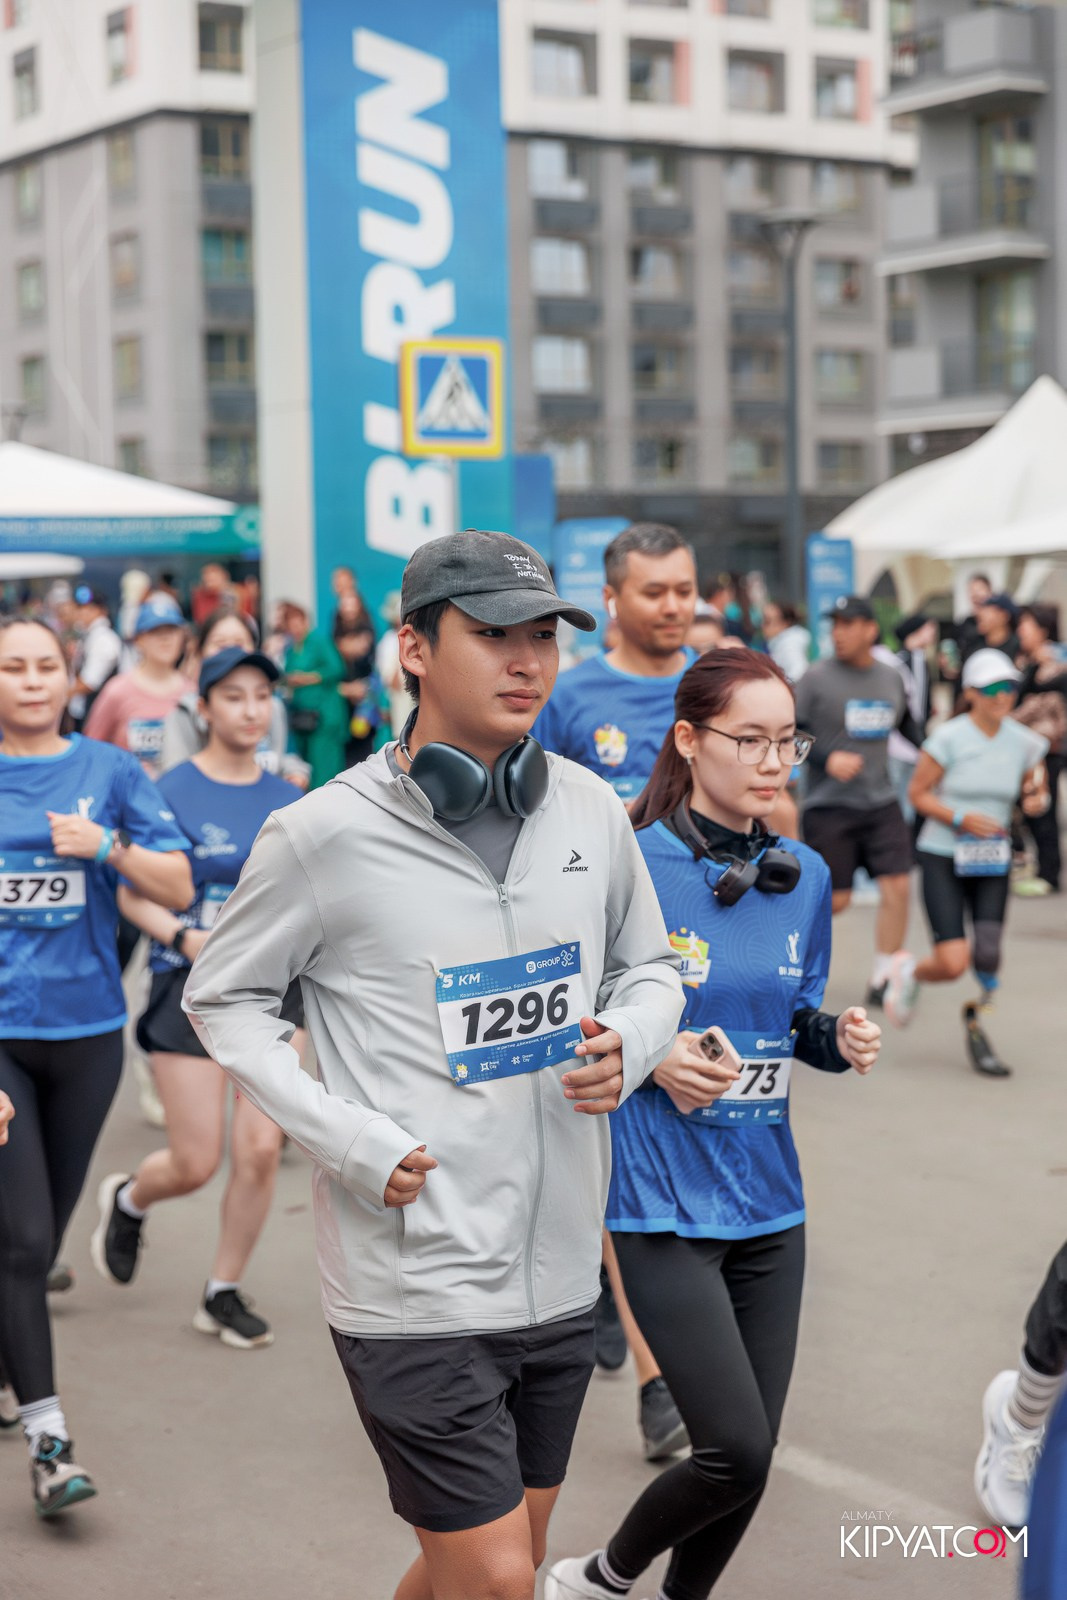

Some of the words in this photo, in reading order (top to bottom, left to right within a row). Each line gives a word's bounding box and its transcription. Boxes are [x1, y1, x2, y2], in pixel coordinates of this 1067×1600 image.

[353, 27, 455, 364] RUN
[0, 877, 68, 903] 379
[536, 956, 561, 969] GROUP
[441, 973, 454, 989] 5
[461, 983, 569, 1045] 1296
[738, 1063, 782, 1095] 73
